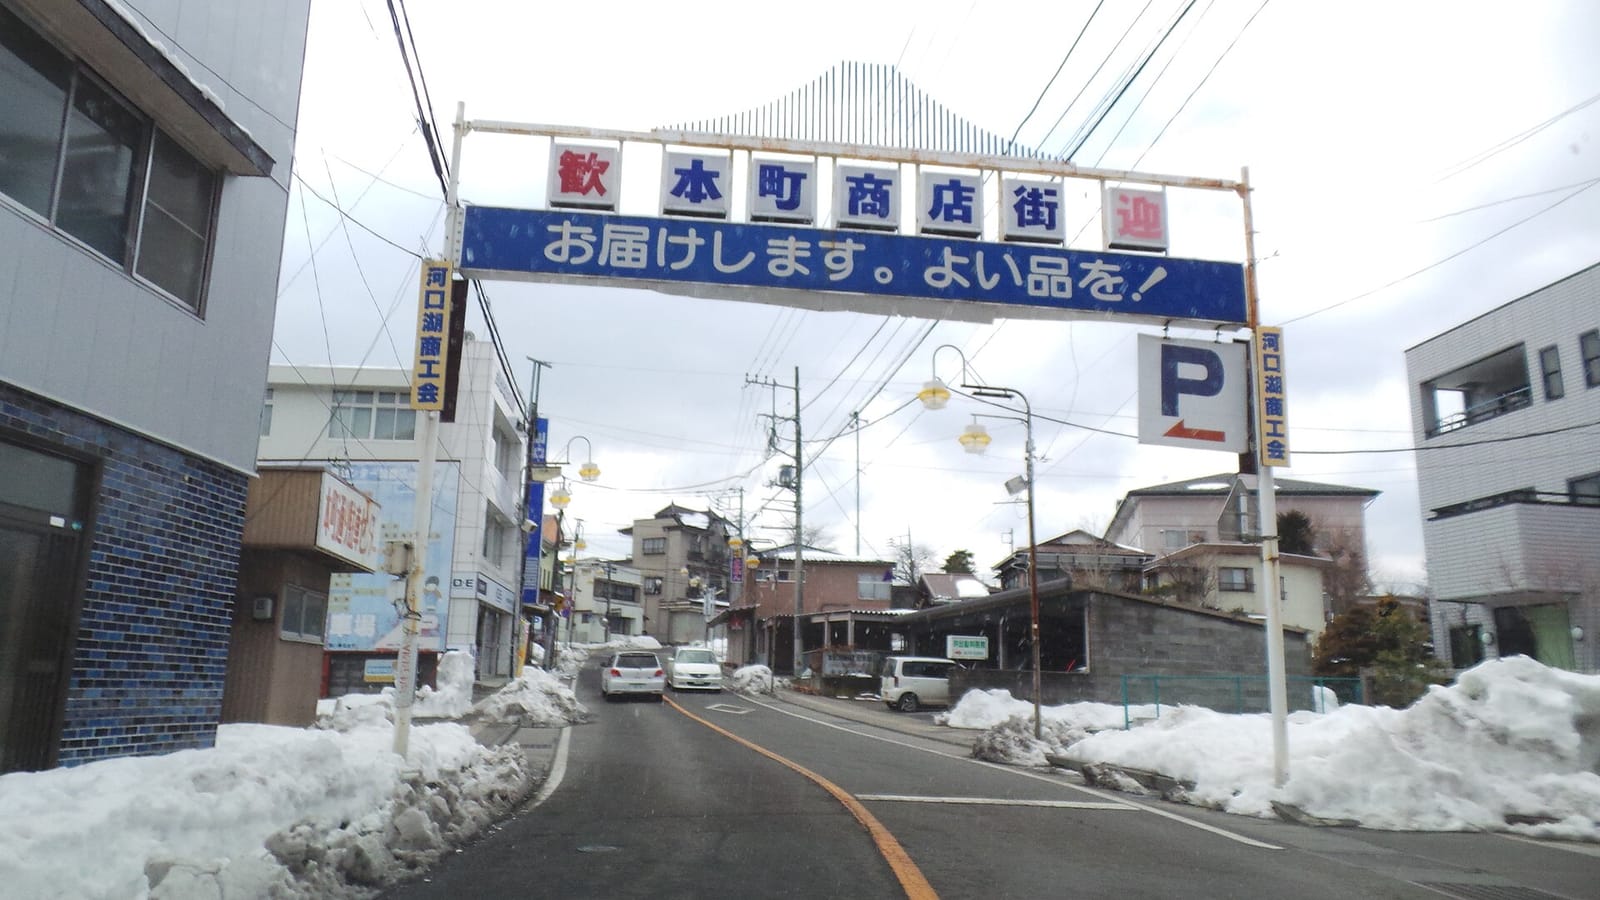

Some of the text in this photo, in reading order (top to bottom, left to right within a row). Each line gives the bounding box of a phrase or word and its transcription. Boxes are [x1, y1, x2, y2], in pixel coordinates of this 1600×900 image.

[559, 149, 1163, 240] 歓 本町商店街 迎
[417, 267, 448, 403] 河口湖商工会
[1161, 343, 1225, 417] P
[1262, 332, 1286, 460] 河口湖商工会
